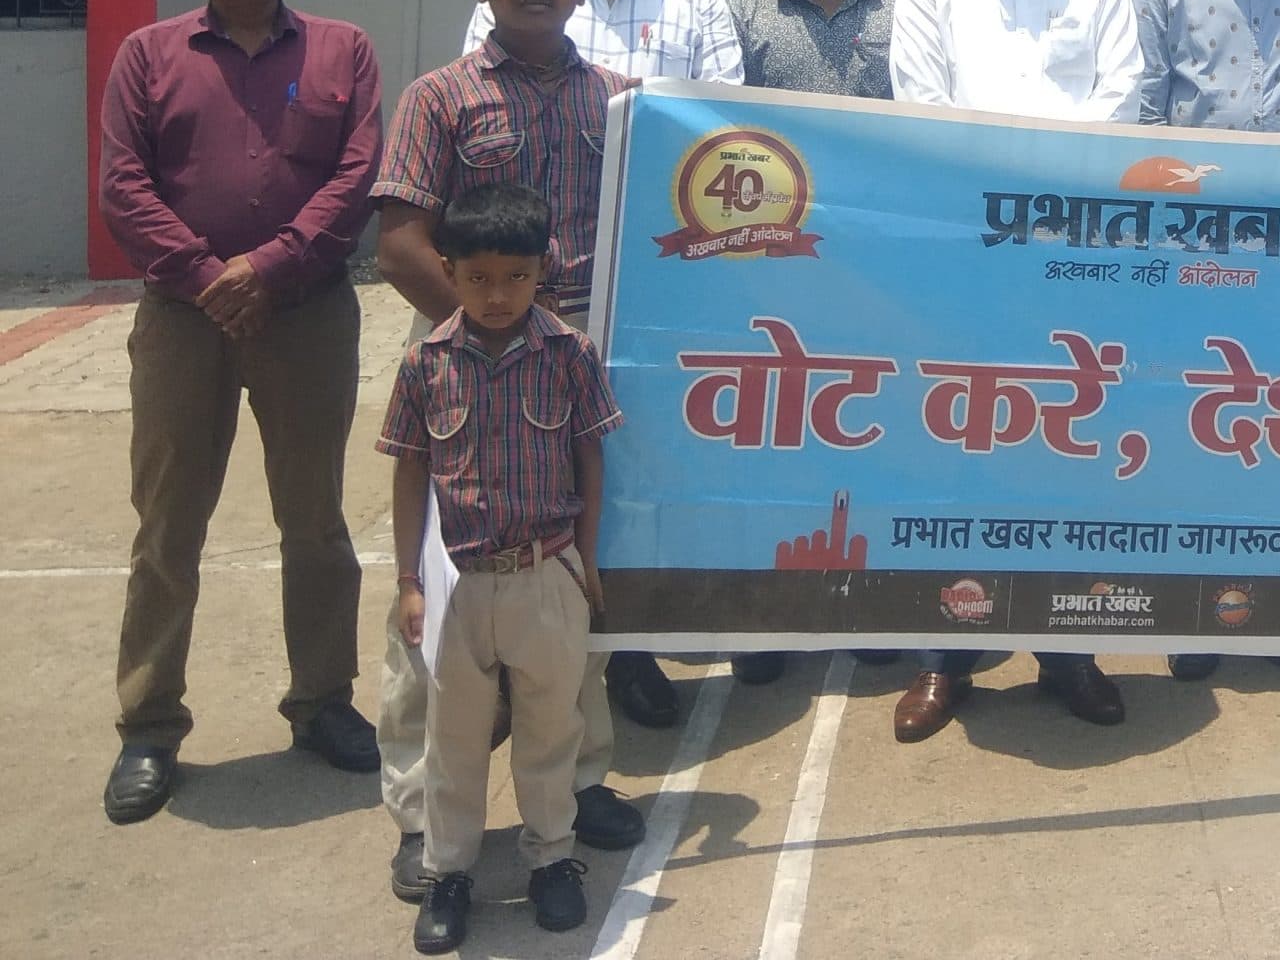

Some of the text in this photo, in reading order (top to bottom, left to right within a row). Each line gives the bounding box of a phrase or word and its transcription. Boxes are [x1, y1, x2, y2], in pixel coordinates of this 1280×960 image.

[703, 163, 764, 213] 40
[981, 191, 1155, 250] प्रभात
[686, 226, 793, 257] अखबार नहीं आंदोलन
[1045, 258, 1259, 289] अखबार नहीं आंदोलन
[677, 315, 899, 450] वोट
[916, 329, 1151, 480] करें,
[890, 516, 975, 549] प्रभात
[980, 518, 1059, 551] खबर
[1063, 520, 1173, 554] मतदाता
[1050, 594, 1154, 613] प्रभात खबर
[1048, 614, 1155, 628] prabhatkhabar.com
